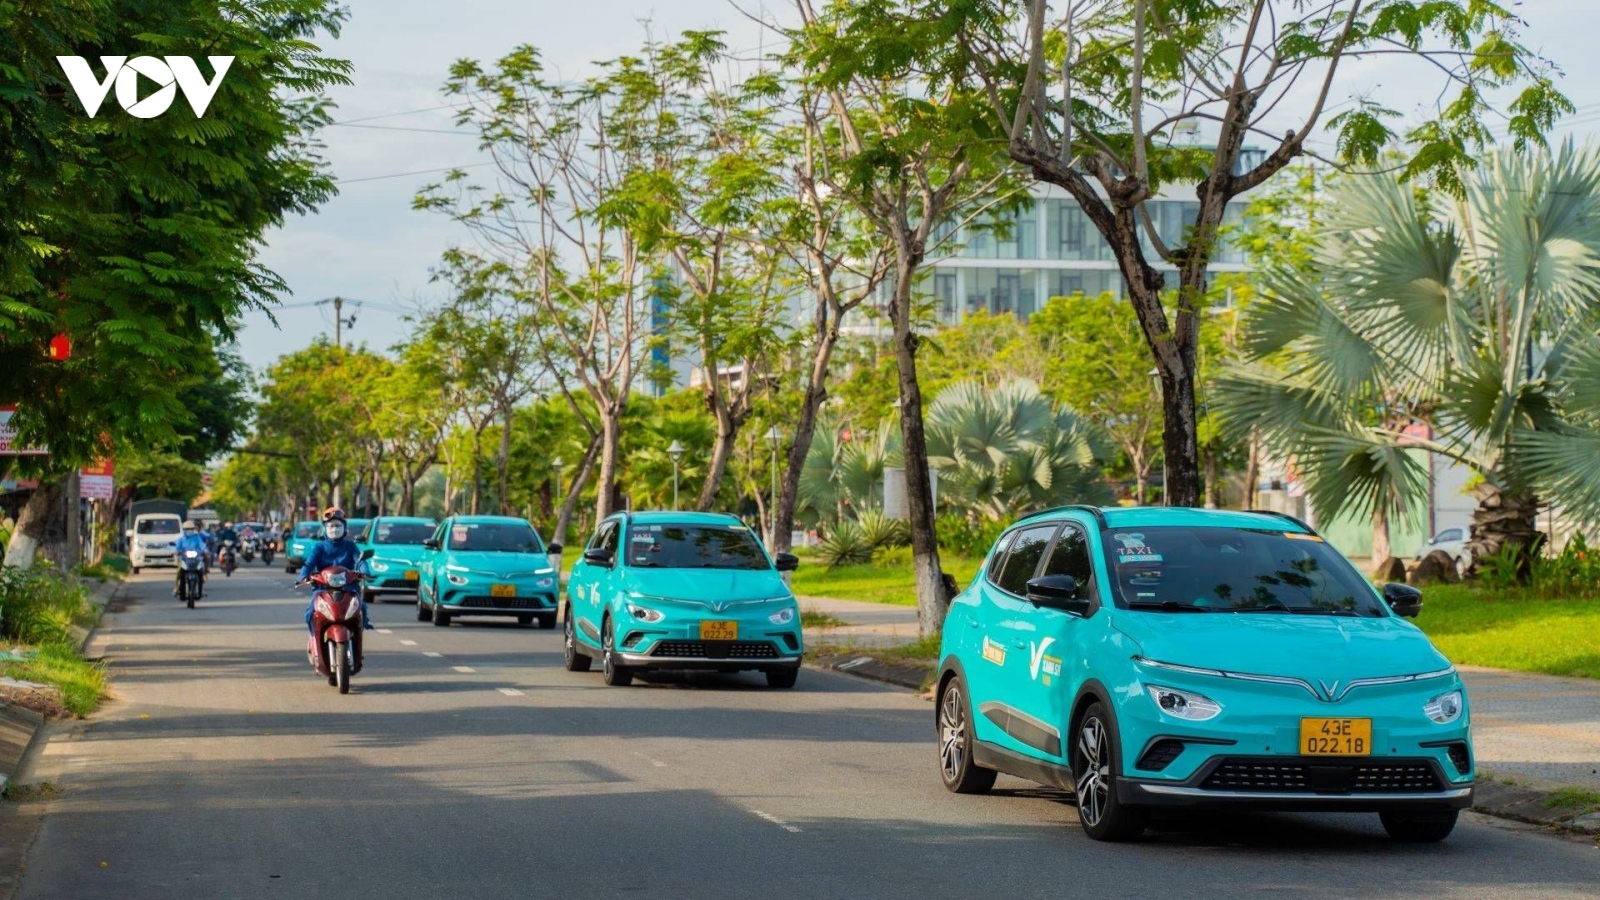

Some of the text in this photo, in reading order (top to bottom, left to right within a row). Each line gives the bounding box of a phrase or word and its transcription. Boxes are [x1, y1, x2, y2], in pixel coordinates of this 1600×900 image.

[1117, 546, 1153, 555] TAXI
[711, 621, 727, 630] 43E
[704, 630, 734, 639] 022.29
[1321, 720, 1352, 736] 43E
[1308, 737, 1364, 753] 022.18
